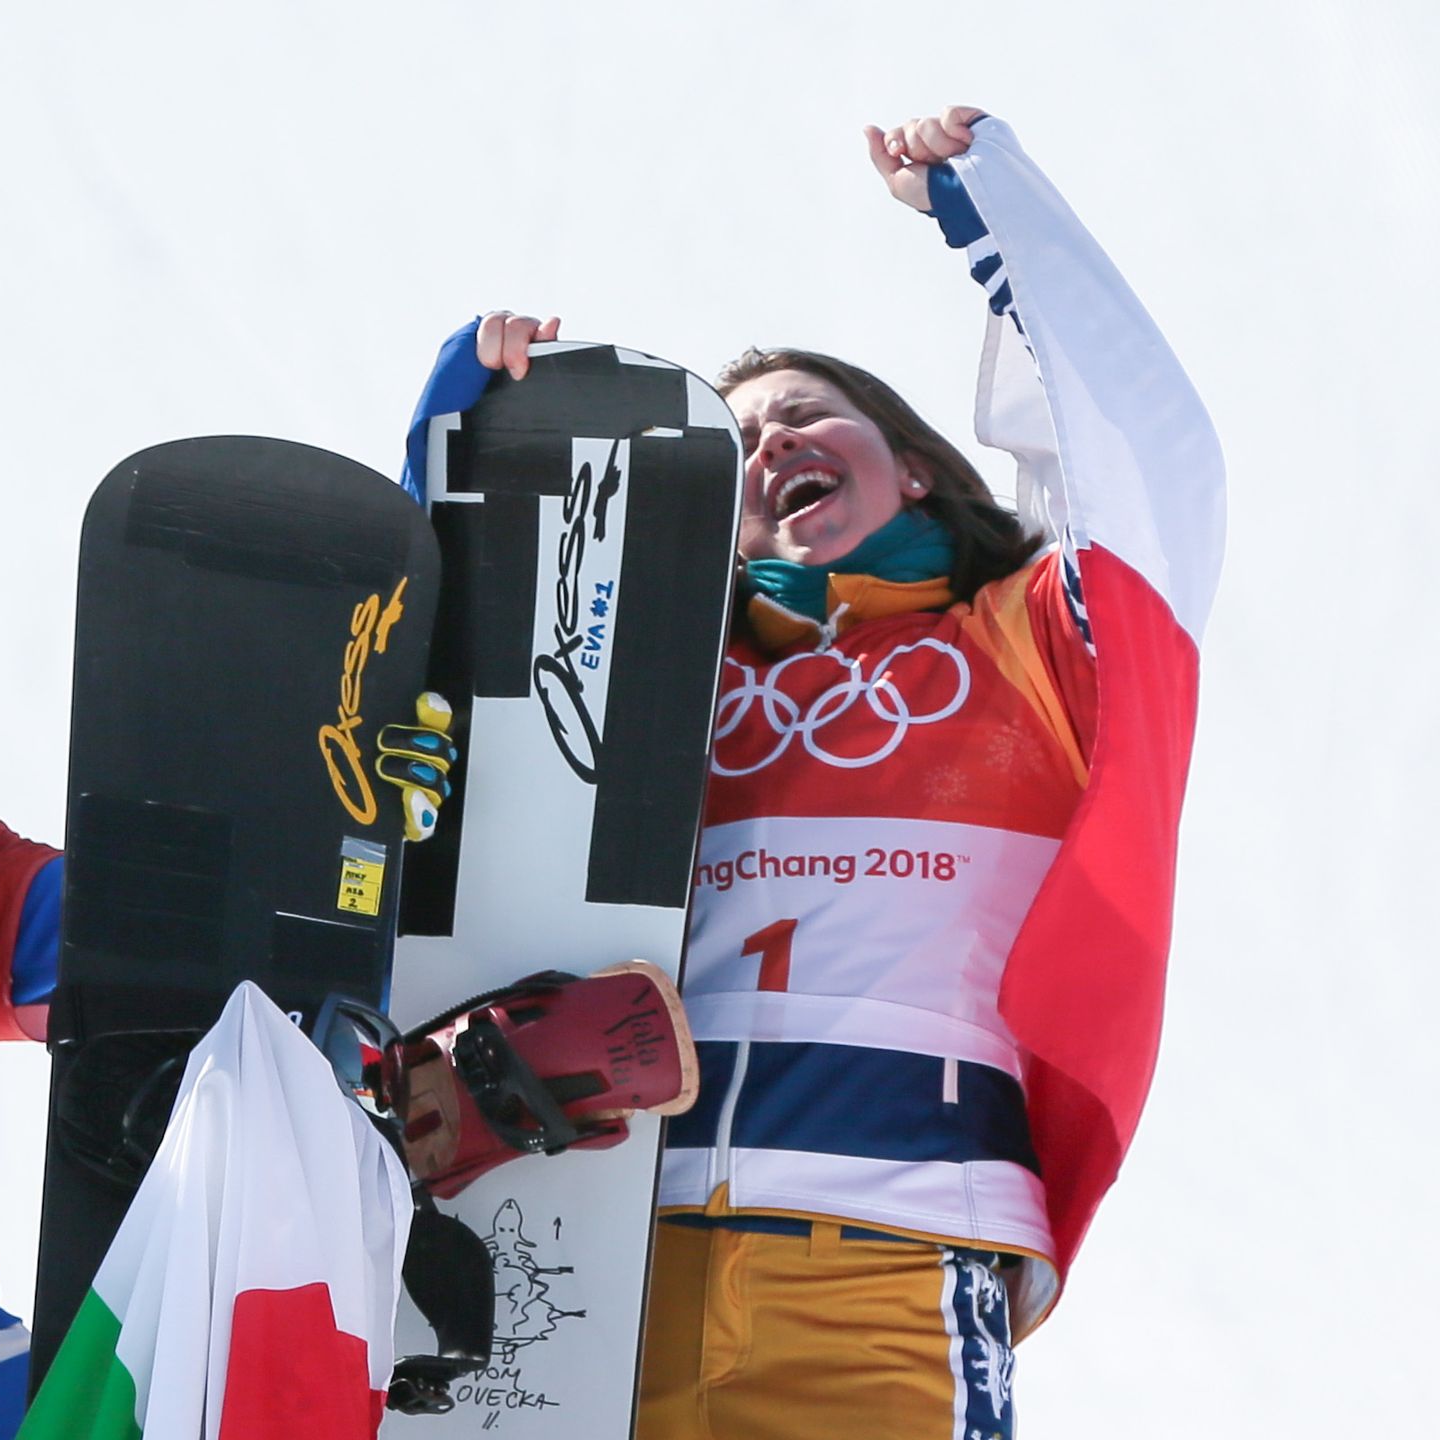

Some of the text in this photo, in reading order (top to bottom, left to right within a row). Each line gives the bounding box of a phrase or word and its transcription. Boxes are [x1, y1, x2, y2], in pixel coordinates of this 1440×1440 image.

[580, 624, 606, 670] EVA
[694, 848, 856, 891] ngChang
[740, 918, 798, 993] 1
